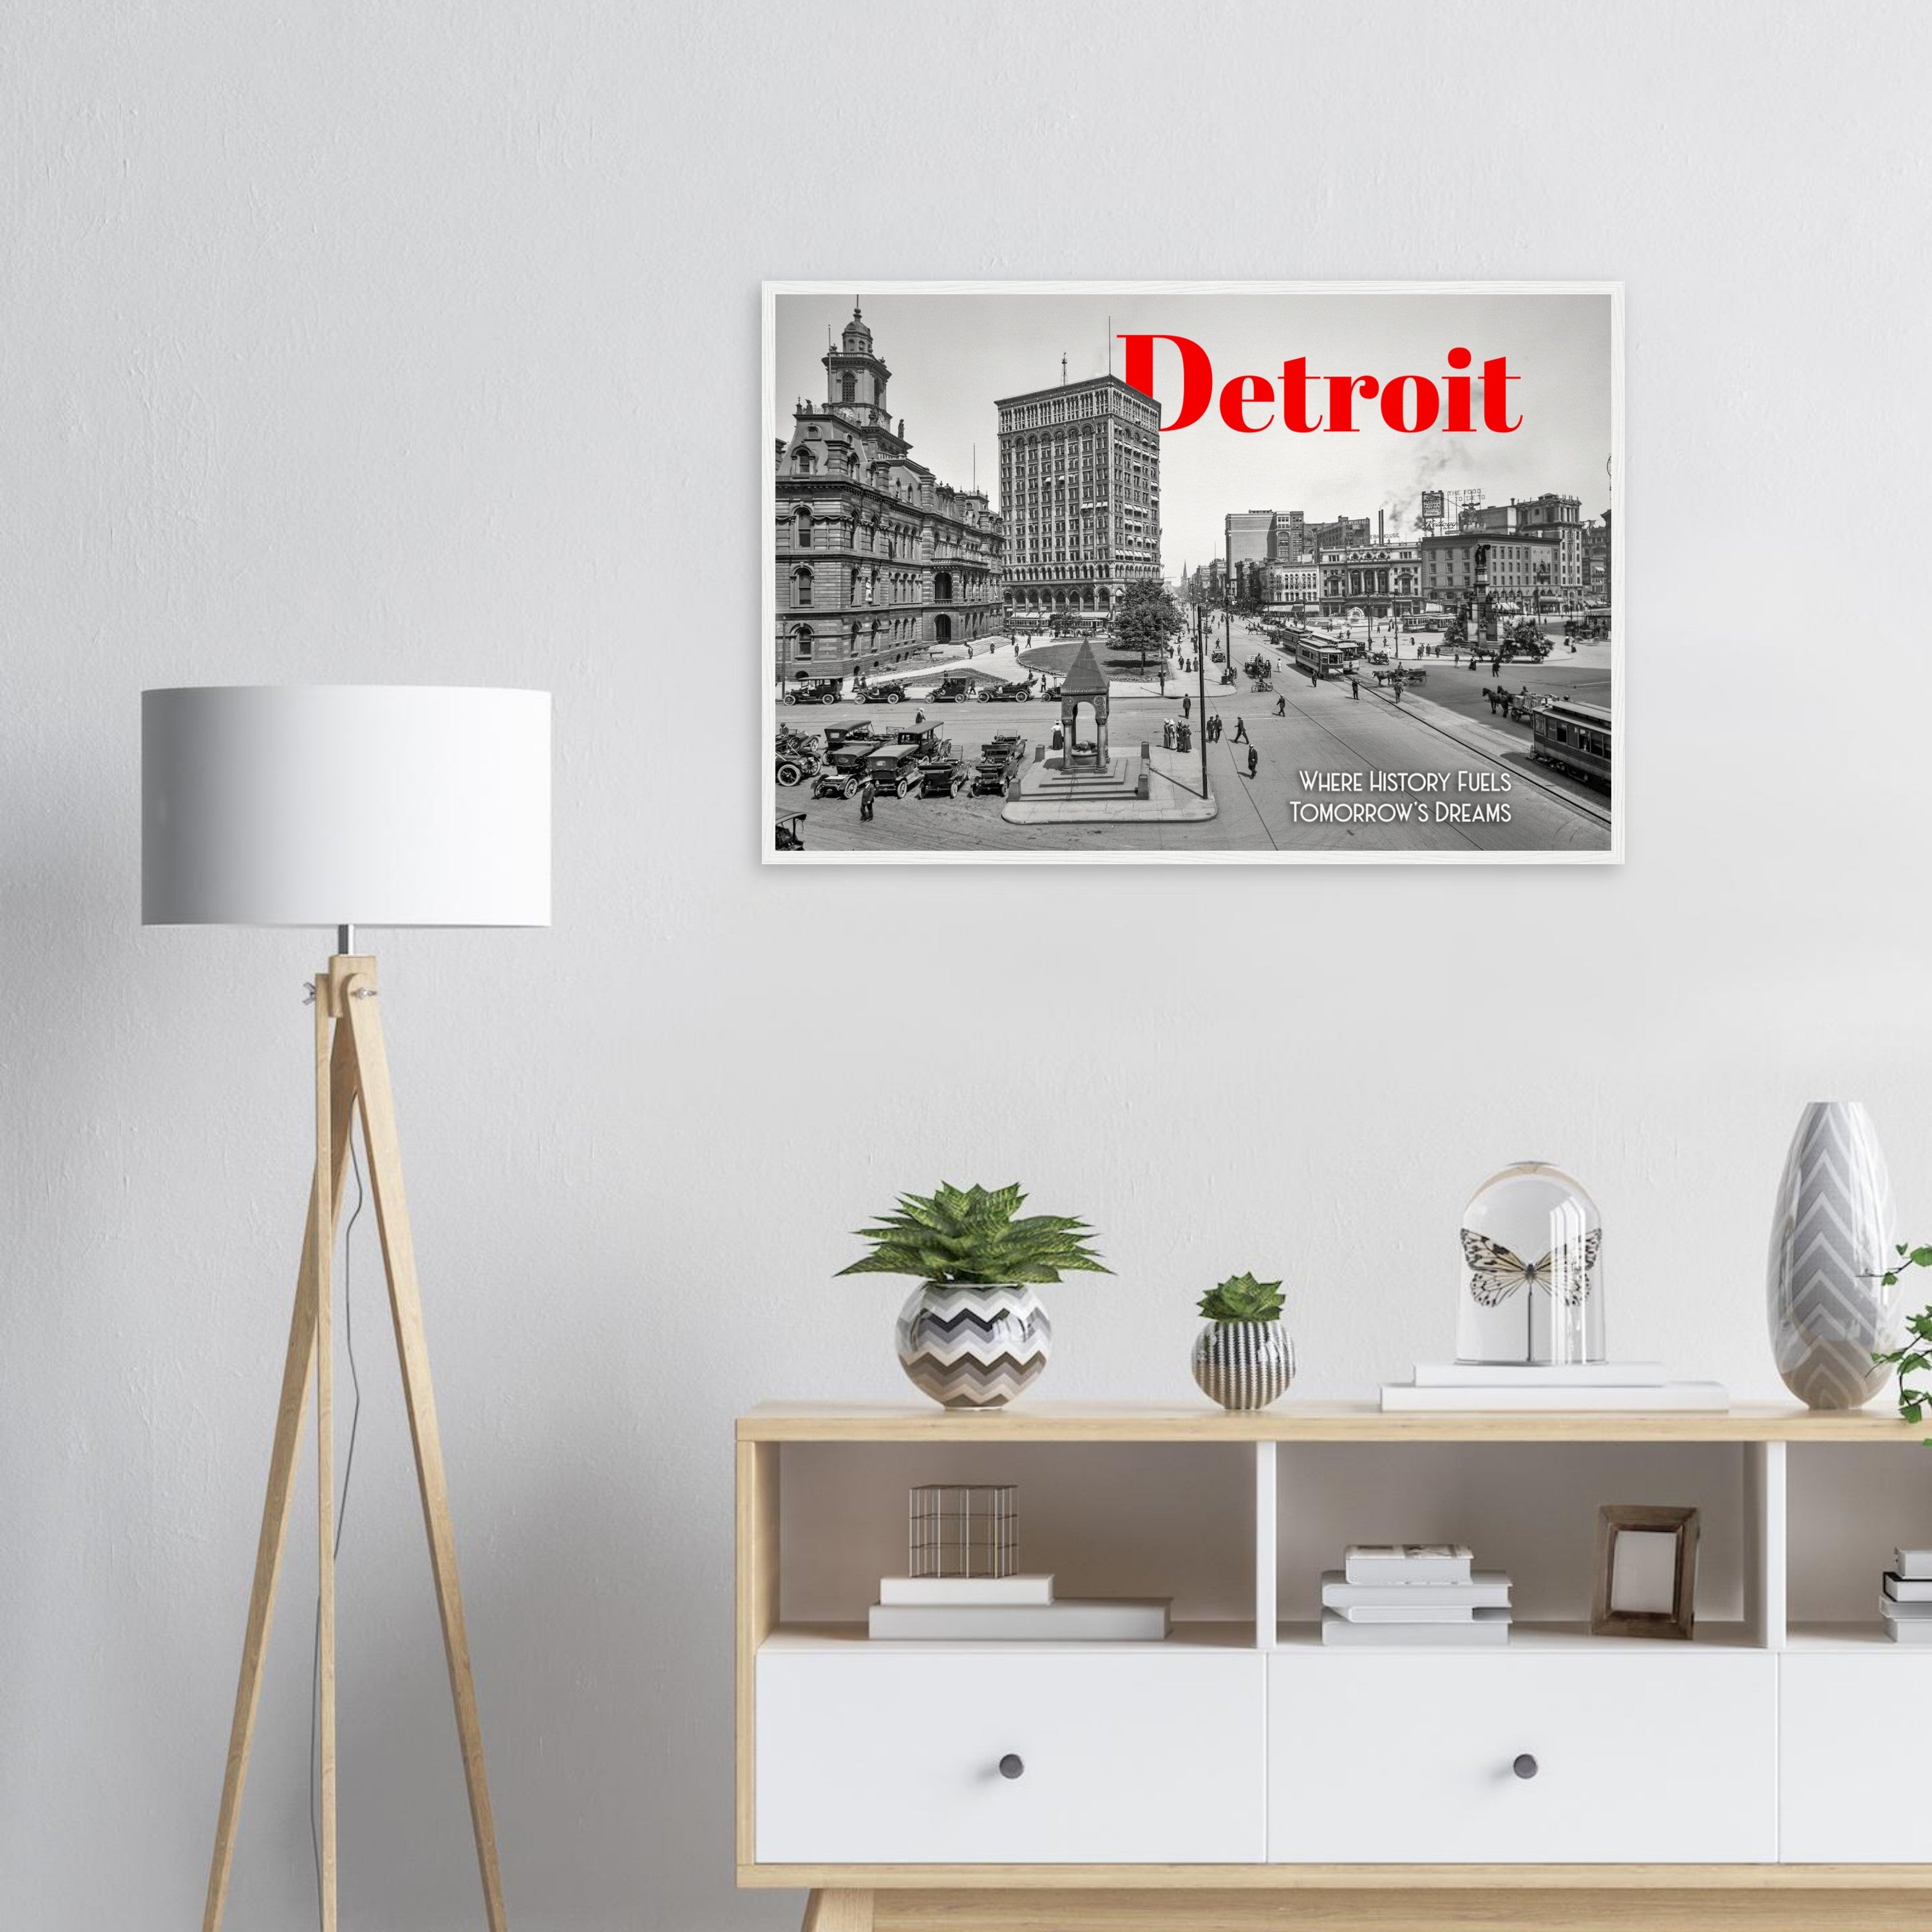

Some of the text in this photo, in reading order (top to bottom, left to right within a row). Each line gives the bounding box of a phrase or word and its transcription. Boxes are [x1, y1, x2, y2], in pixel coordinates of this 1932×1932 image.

[1117, 335, 1522, 433] Detroit
[1300, 771, 1511, 791] WHERE HISTORY FUELS
[1289, 801, 1511, 822] TOMORROW'S DREAMS
